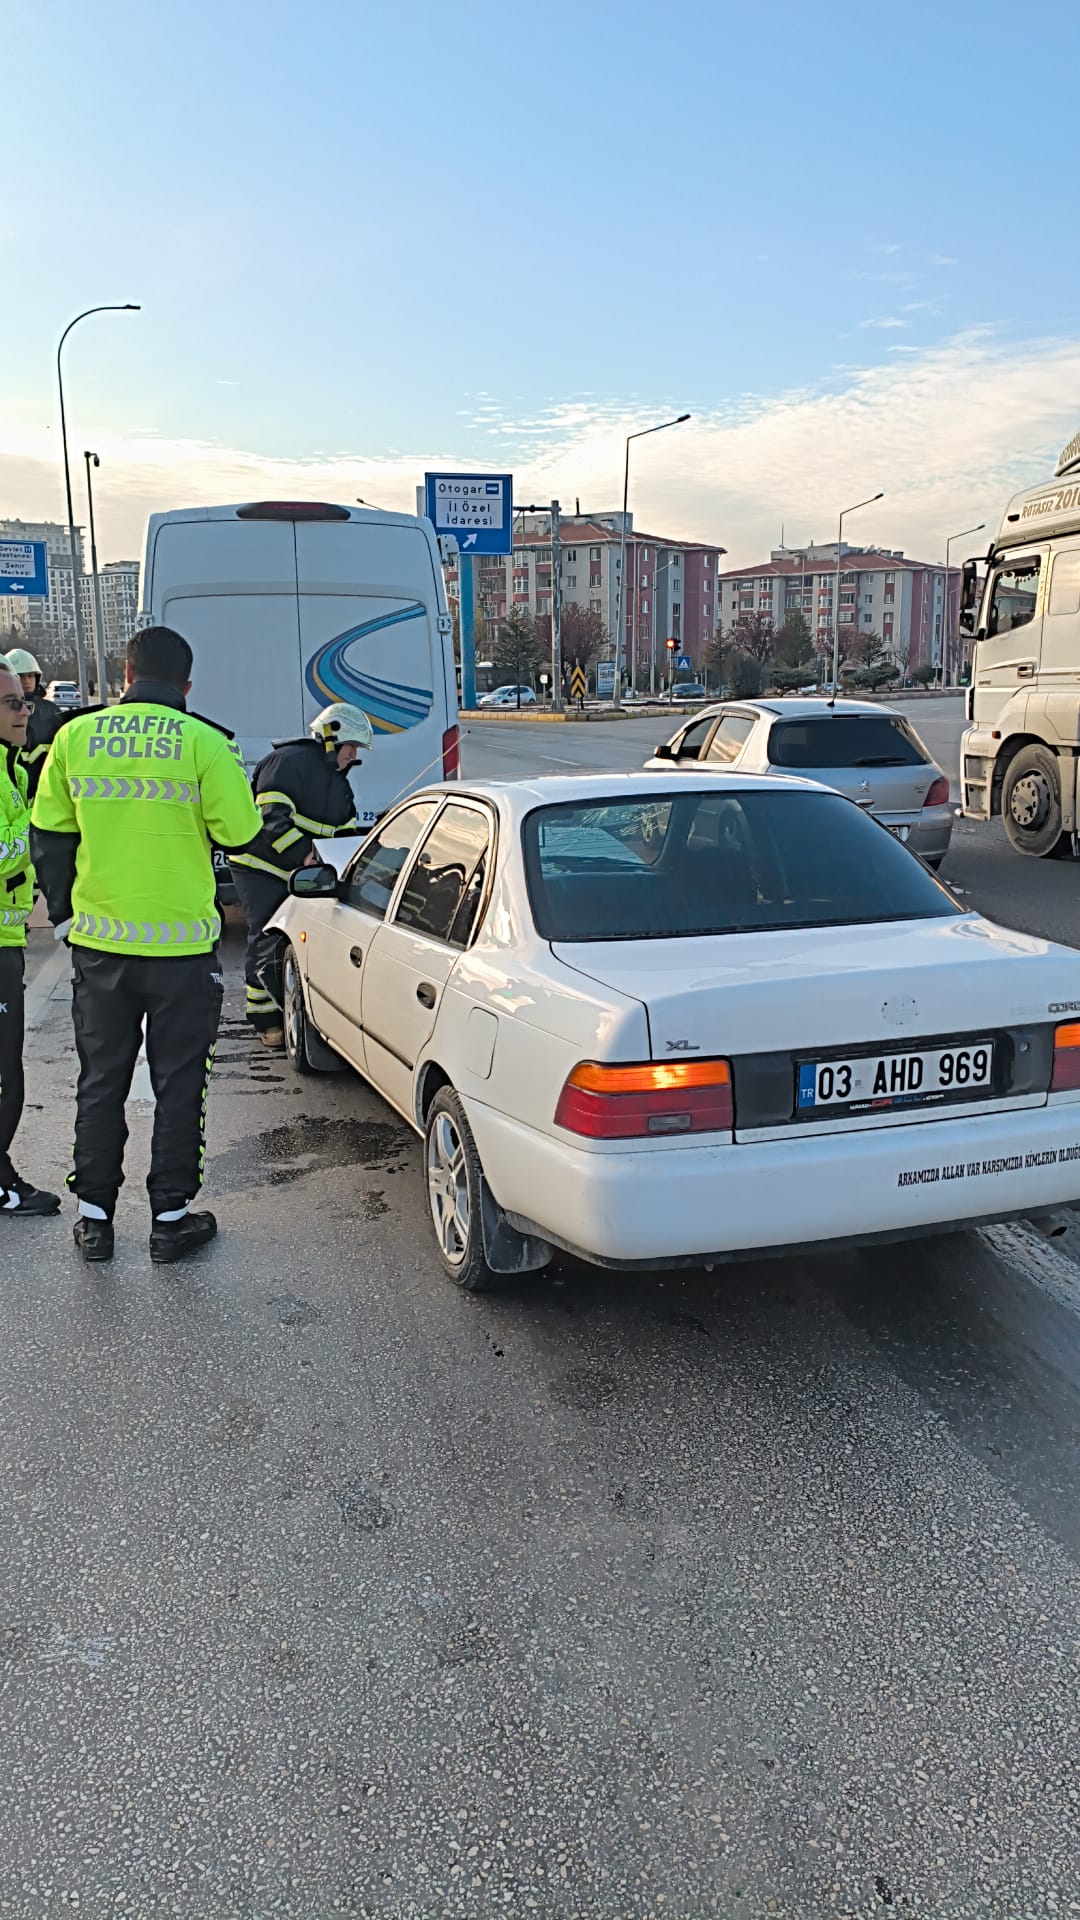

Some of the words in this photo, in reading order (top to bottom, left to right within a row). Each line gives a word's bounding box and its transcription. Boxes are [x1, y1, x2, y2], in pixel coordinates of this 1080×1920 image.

[438, 483, 483, 496] Otogar
[462, 500, 490, 513] Özel
[446, 513, 493, 526] İdaresi
[363, 811, 374, 821] 22
[665, 1040, 700, 1051] XL
[800, 1088, 814, 1099] TR
[818, 1065, 852, 1100] 03
[872, 1056, 923, 1095] AHD
[938, 1049, 988, 1086] 969
[897, 1167, 940, 1187] ARKAMIZDA
[966, 1161, 981, 1177] VAR
[981, 1156, 1023, 1177] KARŞIMIZDA
